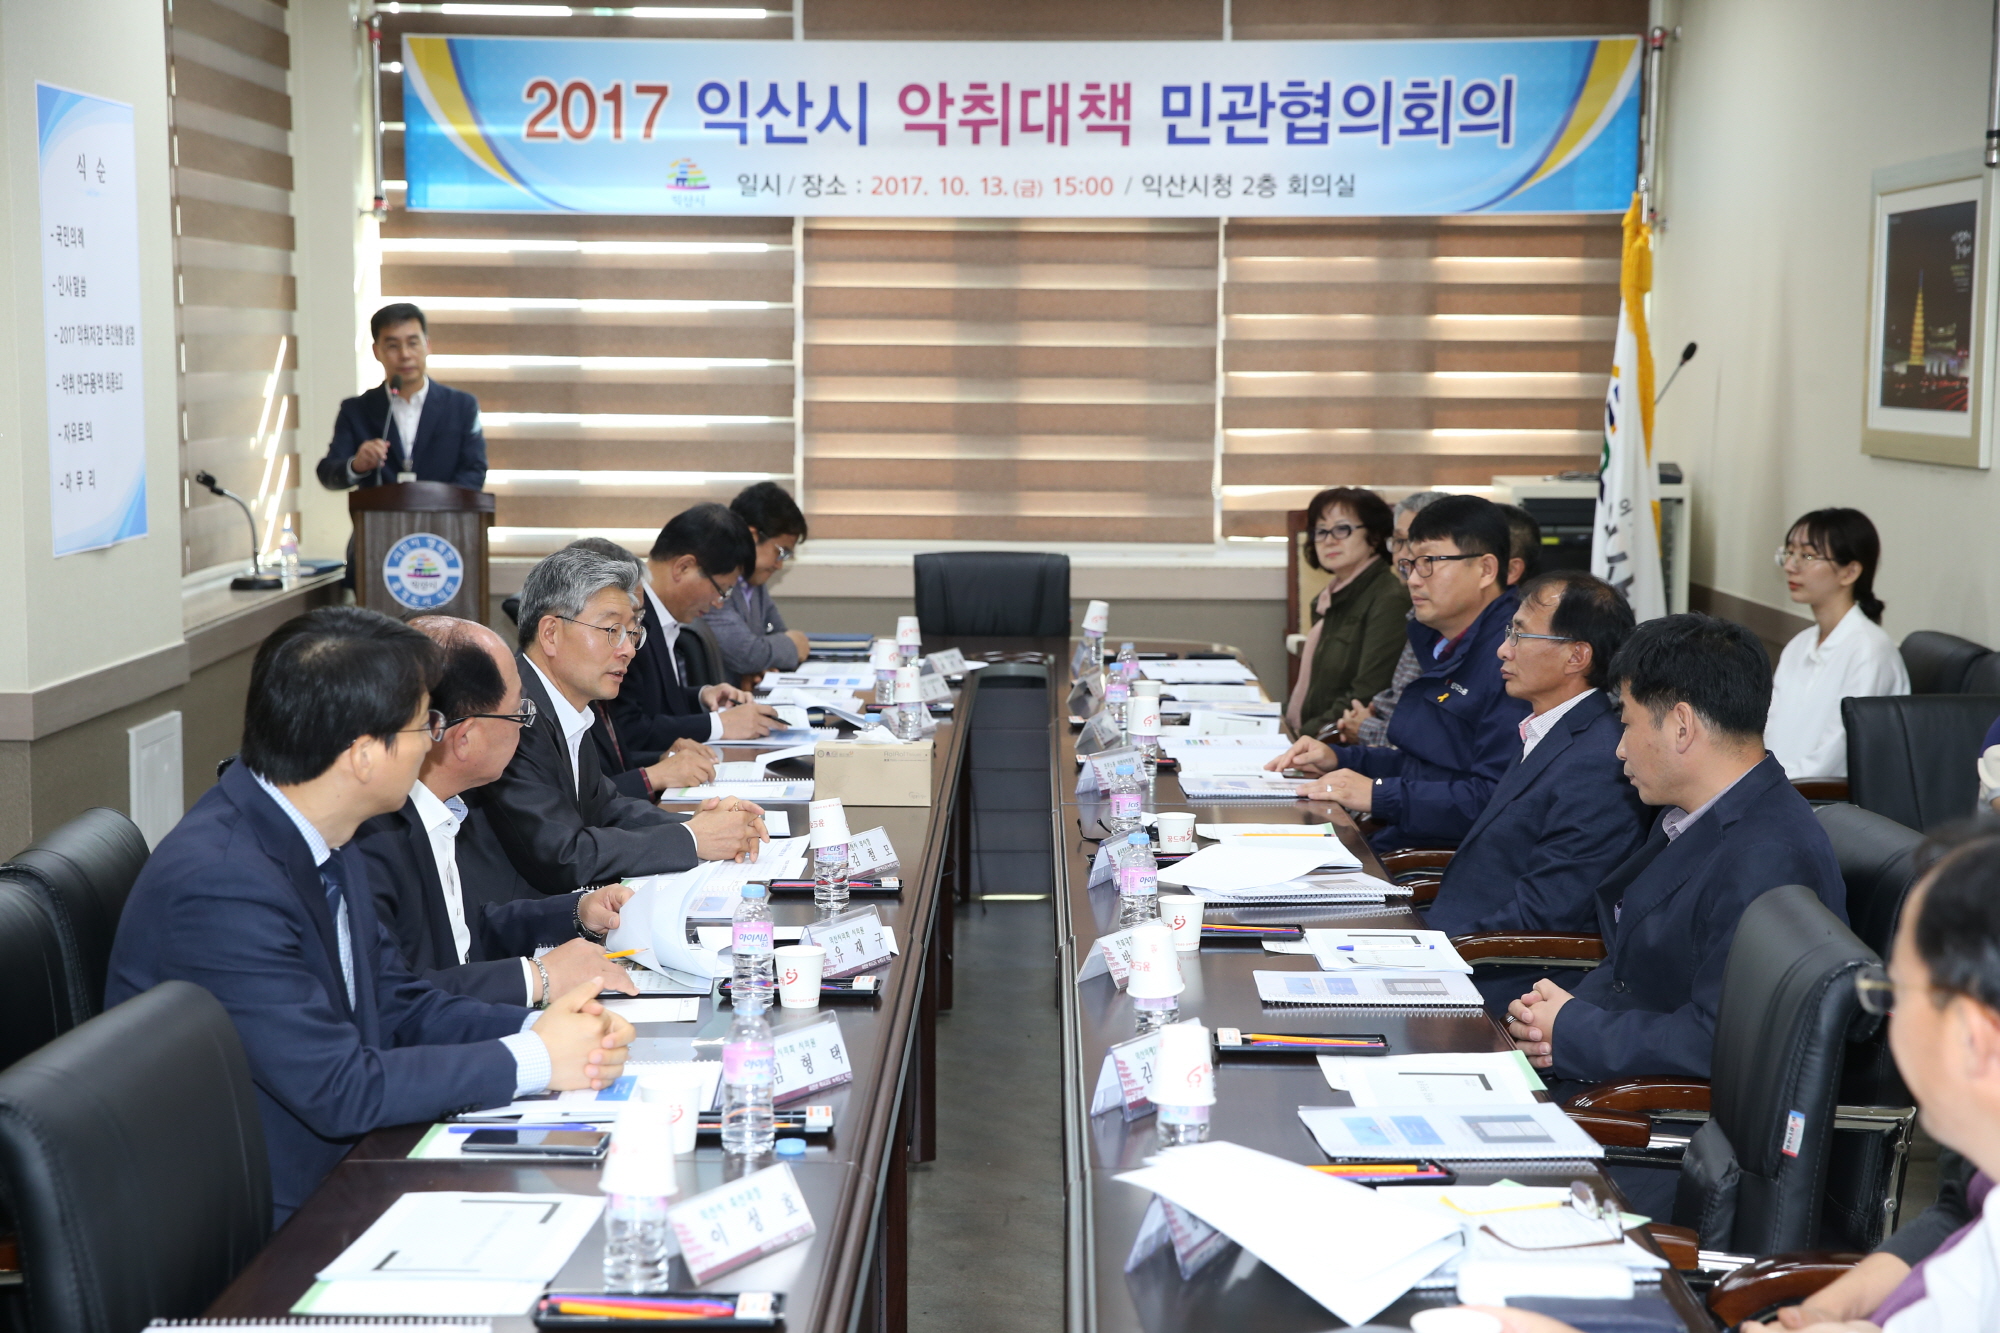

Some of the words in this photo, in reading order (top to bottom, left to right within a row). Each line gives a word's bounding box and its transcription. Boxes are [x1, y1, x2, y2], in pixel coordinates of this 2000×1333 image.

[523, 79, 669, 141] 2017
[697, 80, 868, 146] 익산시
[897, 80, 1132, 147] 악취대책
[1161, 76, 1516, 147] 민관협의회의
[737, 173, 782, 198] 일시
[802, 173, 847, 198] 장소
[871, 176, 929, 197] 2017.
[940, 176, 970, 197] 10.
[1053, 176, 1113, 197] 15:00
[1141, 174, 1233, 199] 익산시청
[1242, 174, 1278, 198] 2층
[1287, 174, 1356, 199] 회의실
[57, 275, 87, 298] 인사말씀
[59, 326, 75, 344] 2017
[62, 372, 75, 395] 악취
[77, 372, 104, 395] 연구용역
[63, 421, 93, 445] 자유토의
[739, 933, 769, 943] 아이시스
